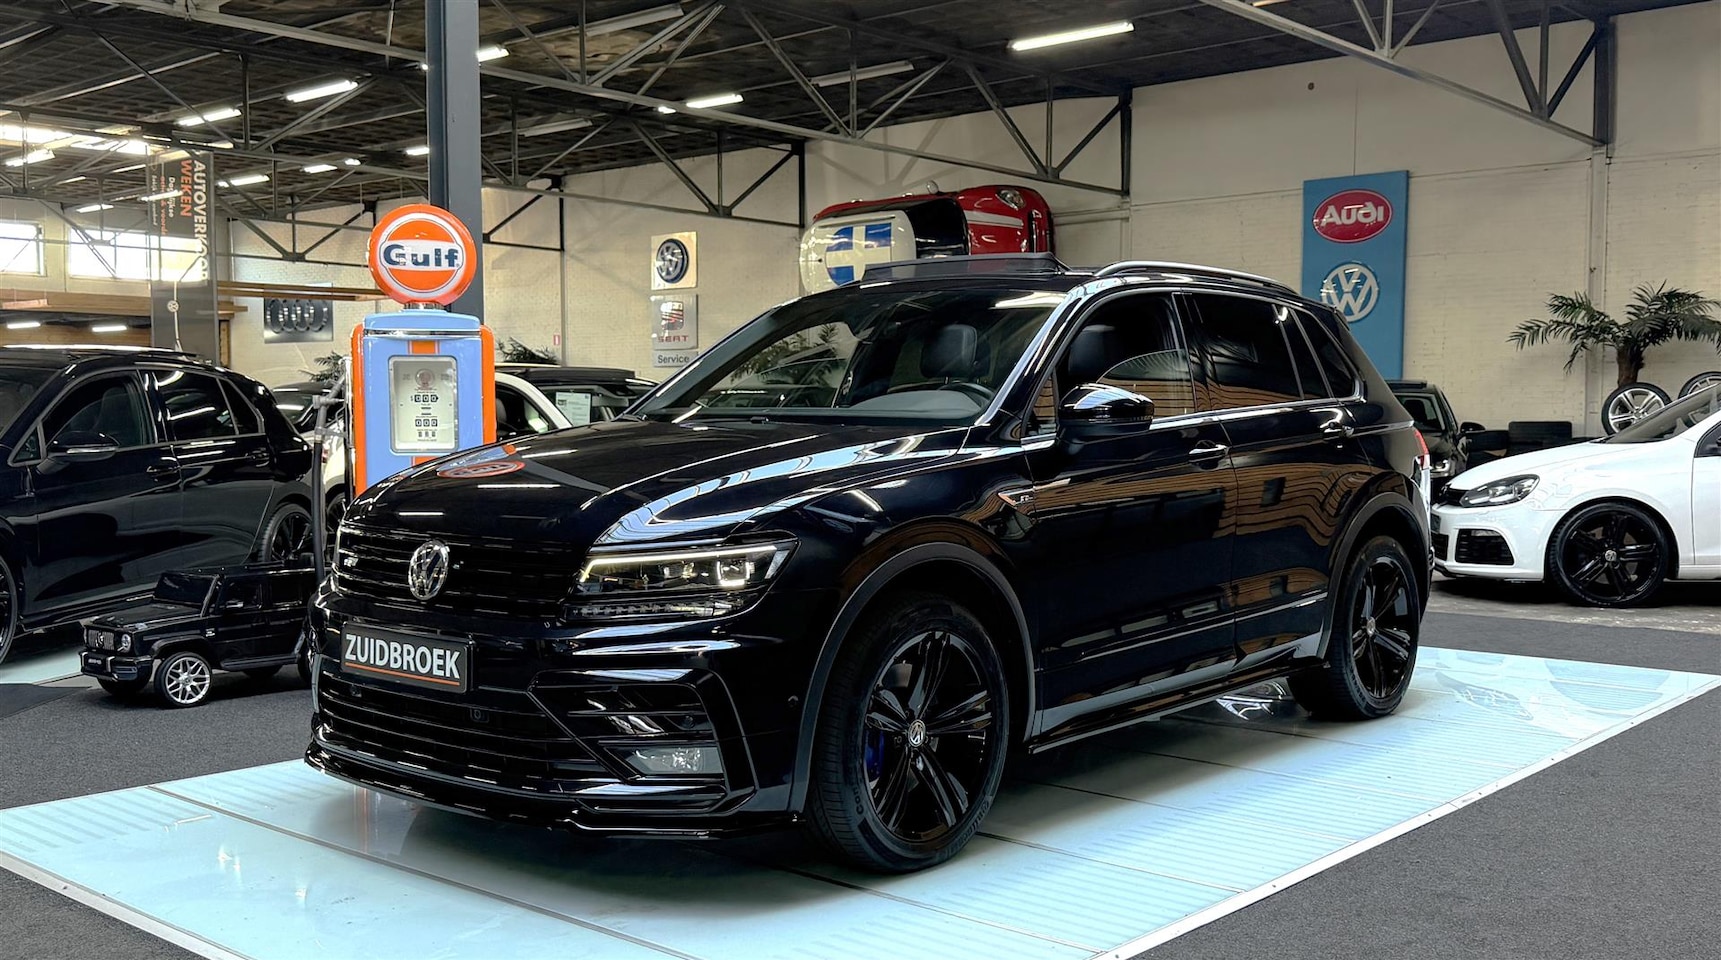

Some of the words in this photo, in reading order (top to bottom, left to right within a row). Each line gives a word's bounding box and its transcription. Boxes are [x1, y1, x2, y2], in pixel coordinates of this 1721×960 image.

[180, 160, 192, 216] WEKEN
[383, 244, 459, 268] Gulf
[657, 355, 690, 364] Service
[344, 634, 460, 679] ZUIDBROEK
